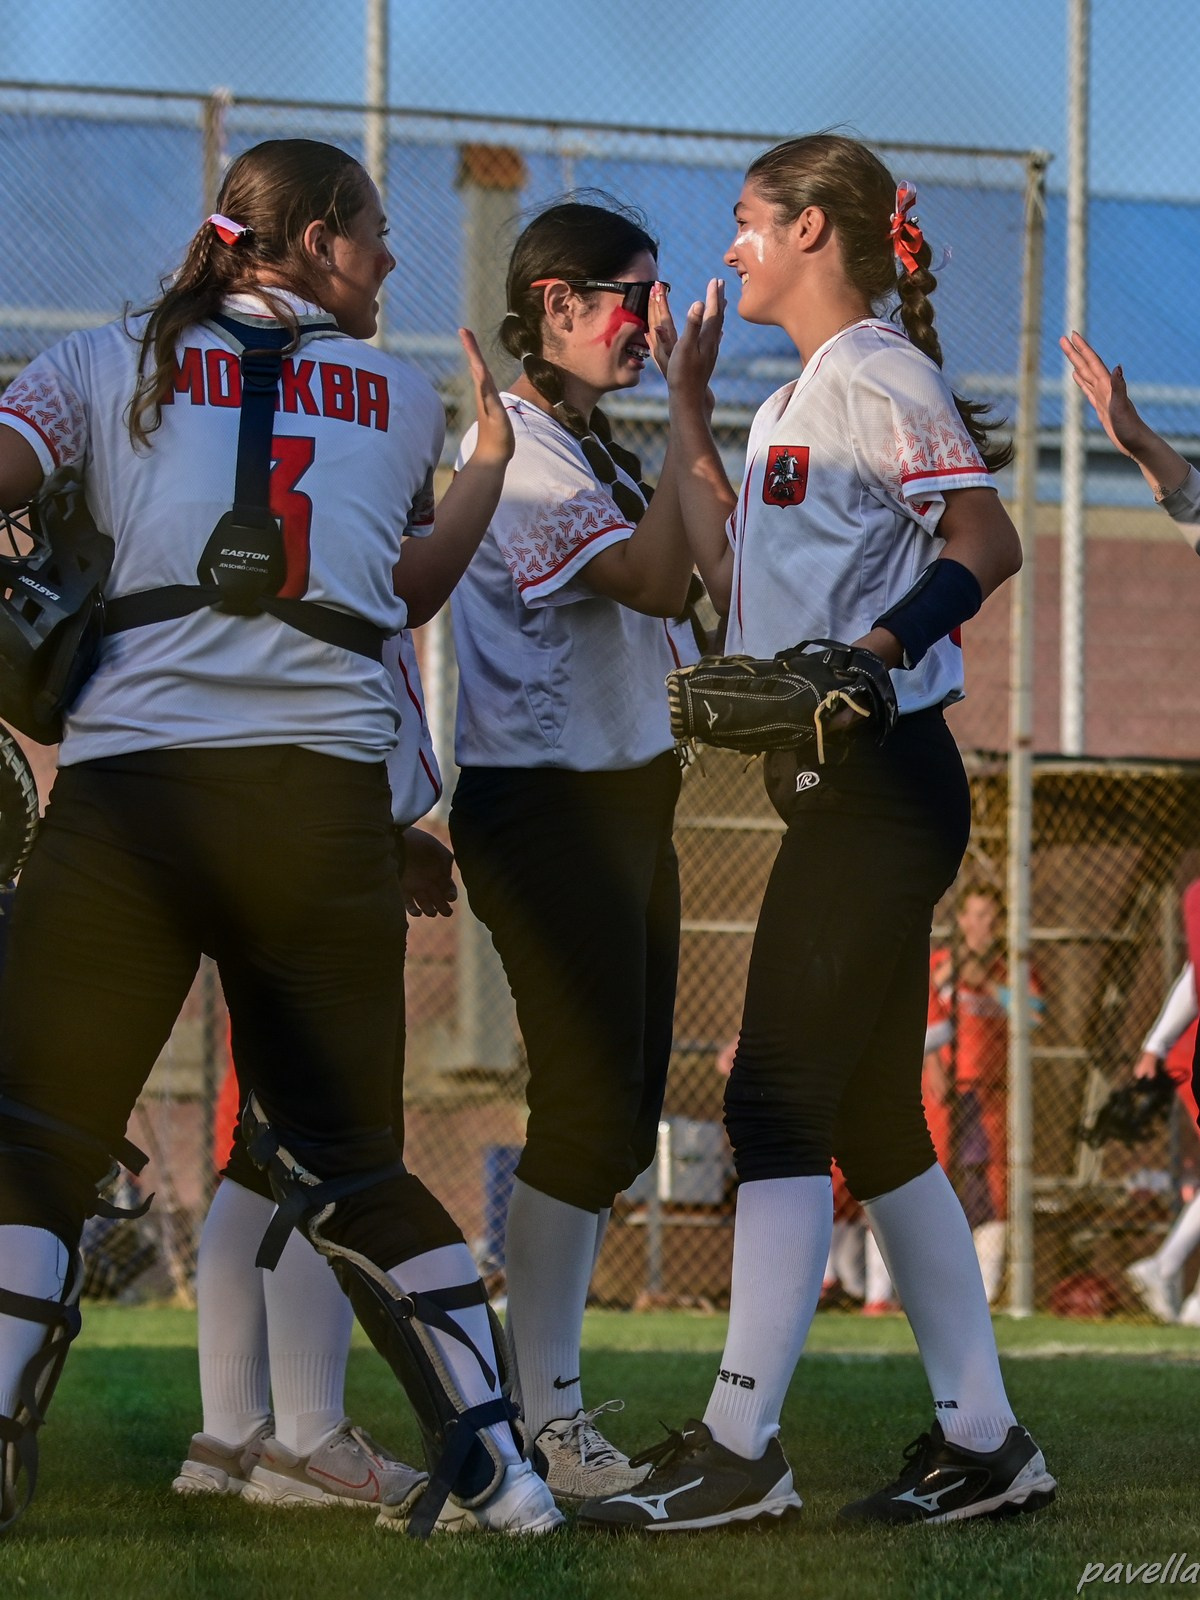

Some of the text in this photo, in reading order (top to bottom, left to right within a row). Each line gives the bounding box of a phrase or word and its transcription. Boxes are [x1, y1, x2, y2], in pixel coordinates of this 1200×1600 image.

[160, 346, 390, 433] МОКВА
[220, 548, 270, 561] EASTON
[18, 575, 61, 601] EASTON
